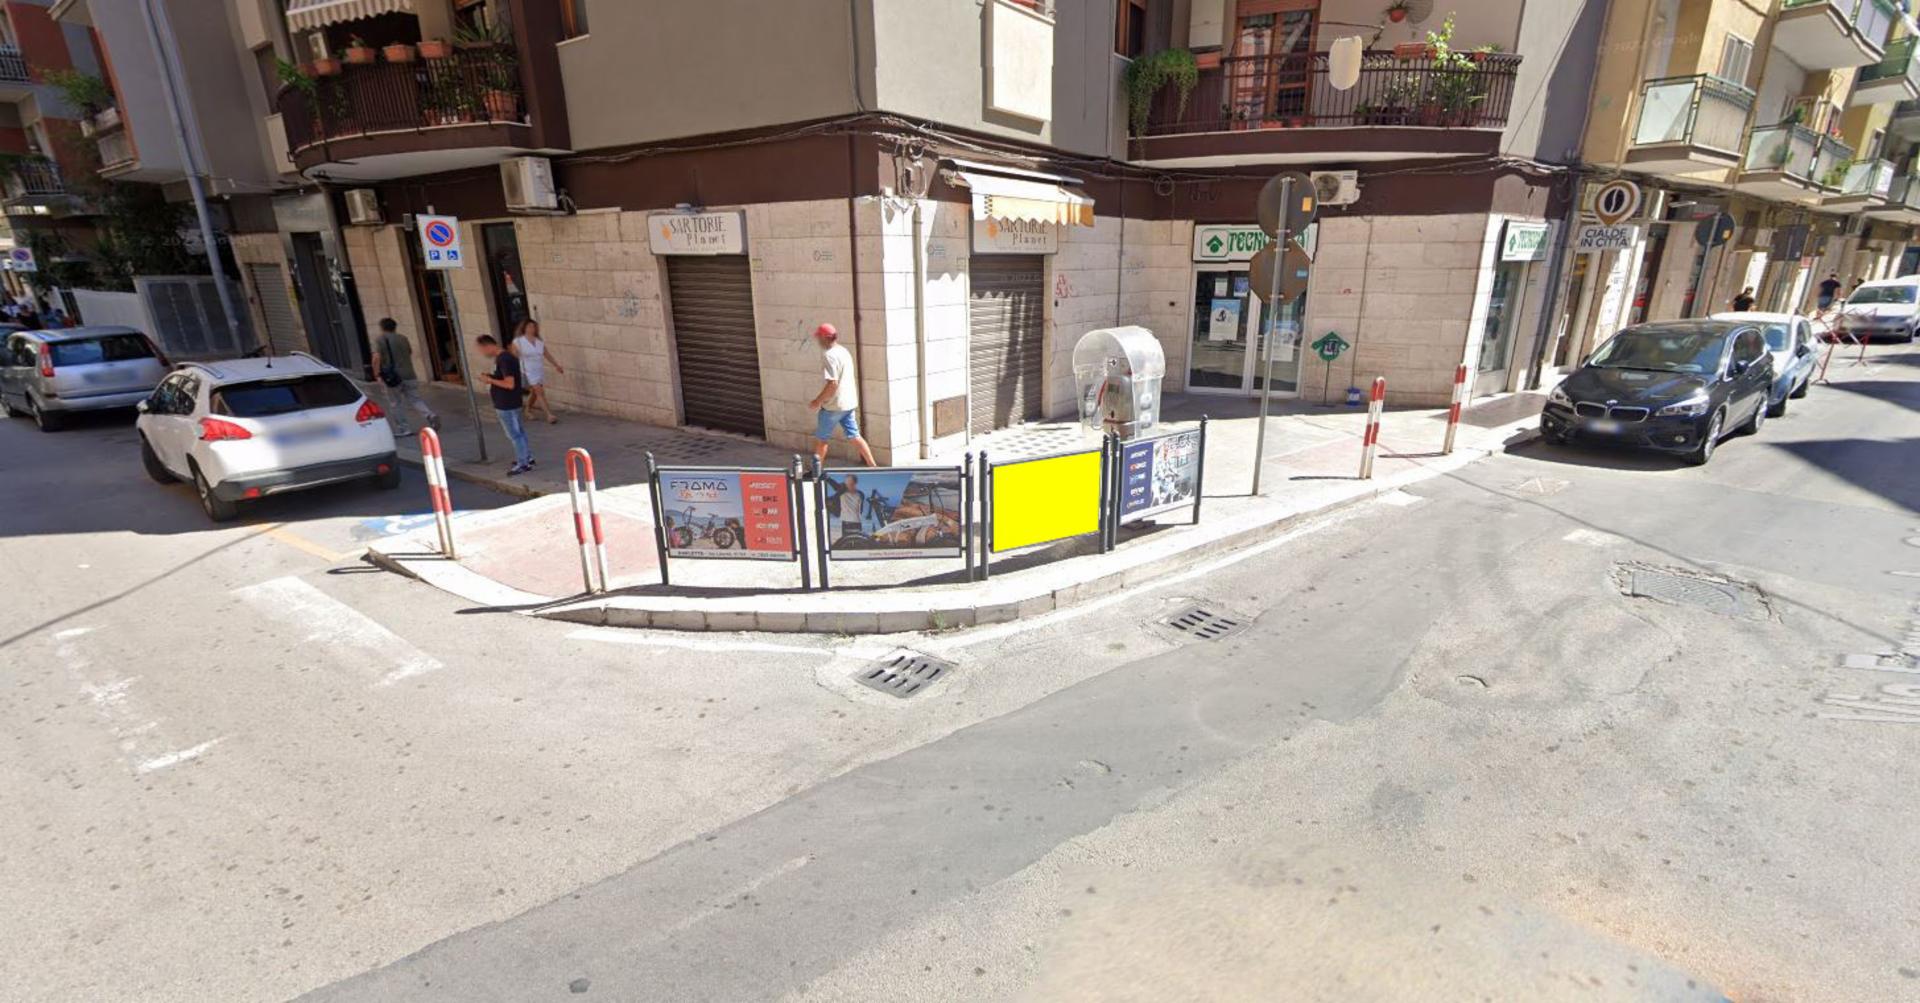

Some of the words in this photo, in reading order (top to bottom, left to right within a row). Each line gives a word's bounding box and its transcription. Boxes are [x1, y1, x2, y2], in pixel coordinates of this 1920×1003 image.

[669, 216, 727, 234] SARTORIE
[1012, 233, 1047, 245] Planet
[1580, 238, 1593, 248] IN
